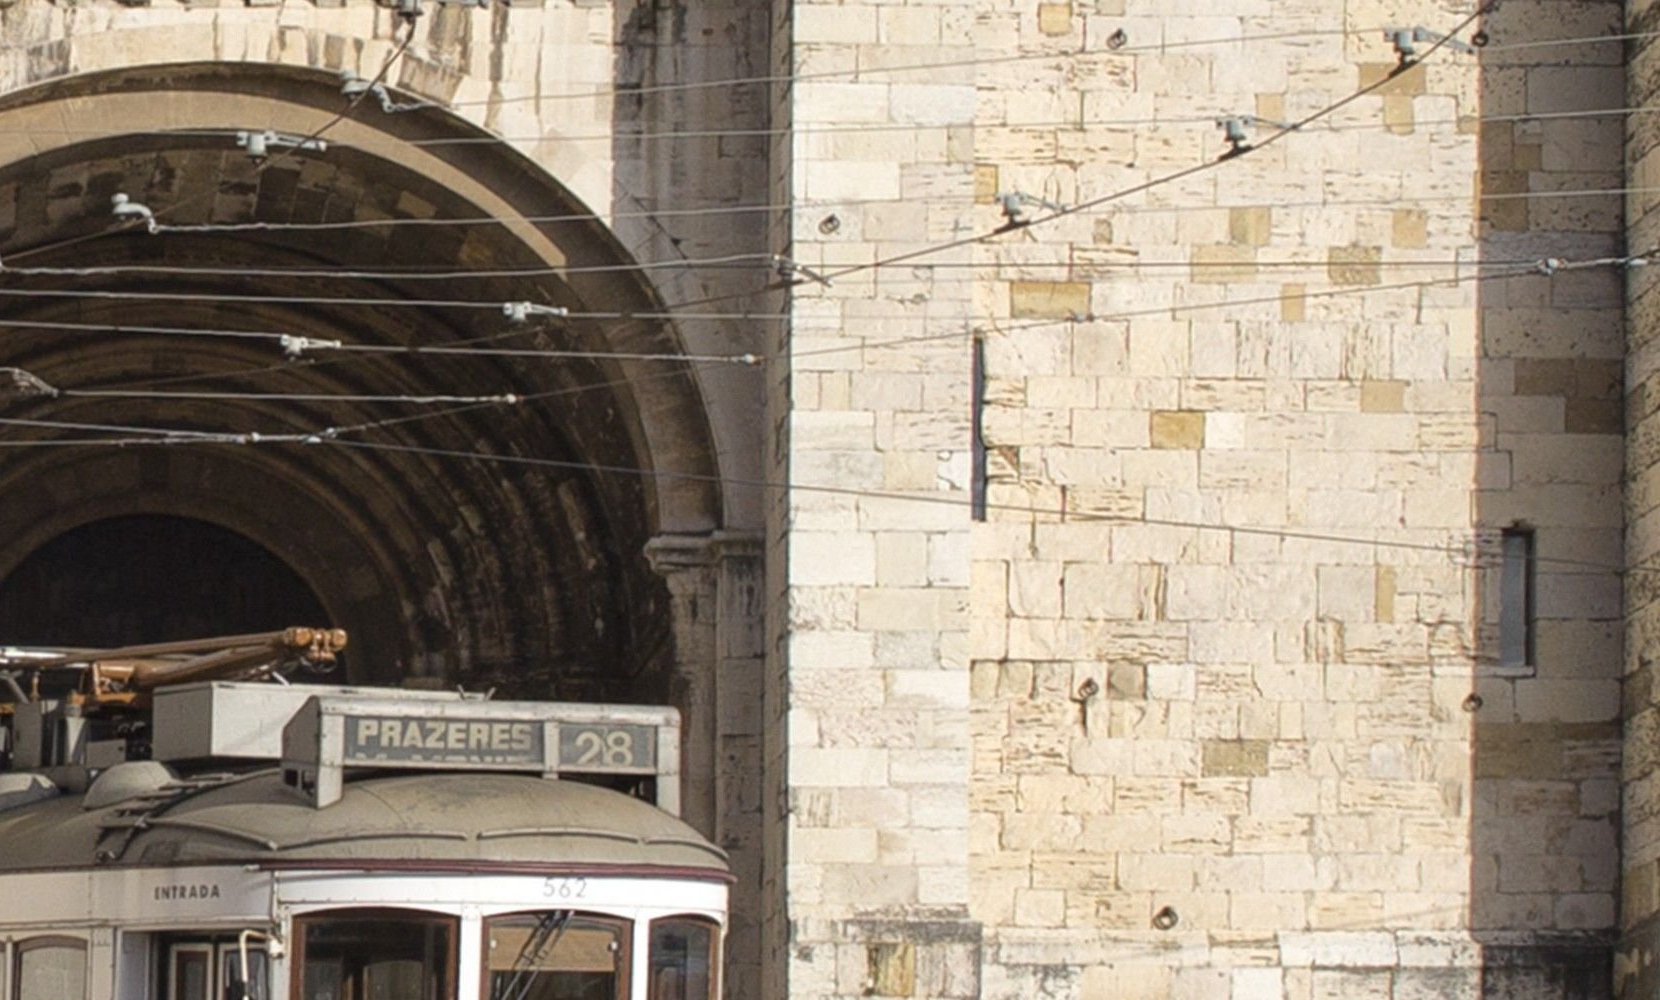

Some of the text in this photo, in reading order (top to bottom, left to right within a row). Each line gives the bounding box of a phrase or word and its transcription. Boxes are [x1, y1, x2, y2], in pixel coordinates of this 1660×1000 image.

[357, 719, 532, 750] PRAZERES
[576, 731, 633, 768] 28
[154, 884, 220, 900] ENTRADA
[542, 877, 587, 898] 562
